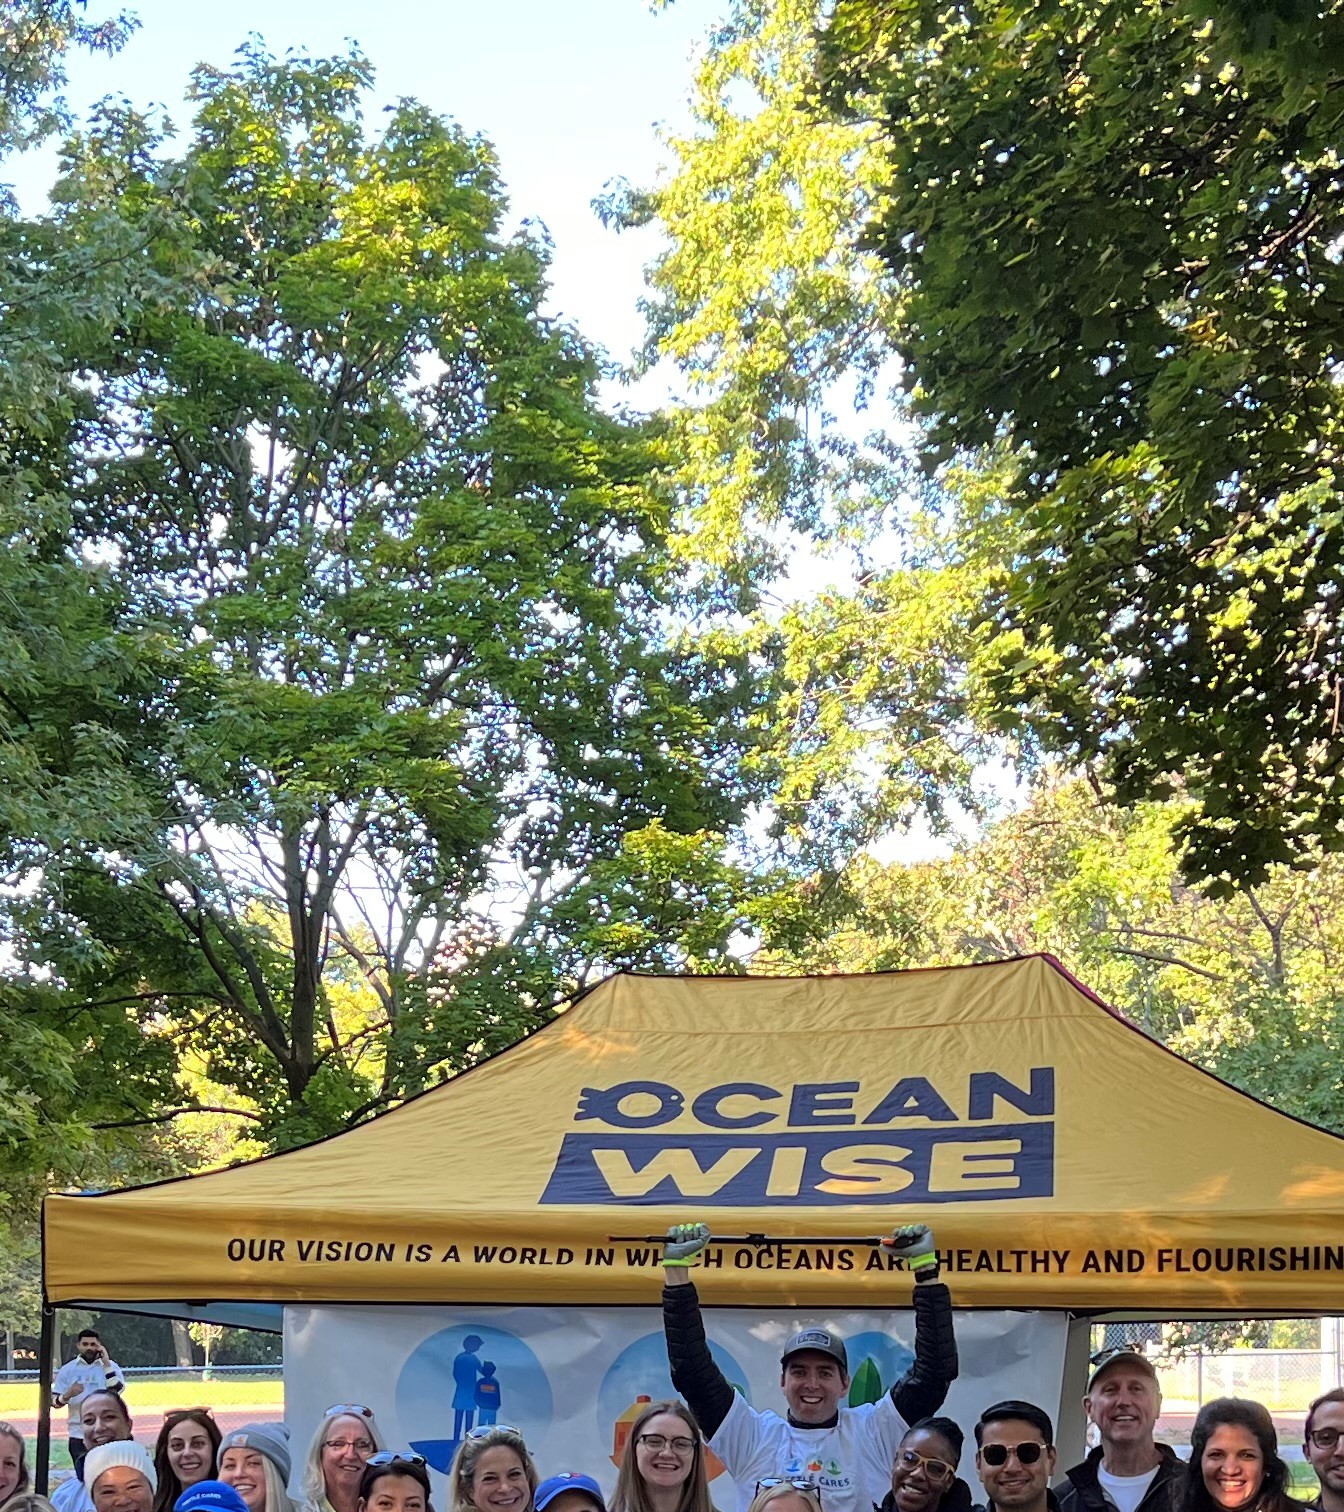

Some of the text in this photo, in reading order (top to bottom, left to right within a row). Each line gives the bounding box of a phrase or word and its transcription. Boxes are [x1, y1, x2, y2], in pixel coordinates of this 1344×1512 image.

[574, 1067, 1055, 1128] OCEAN
[592, 1138, 1023, 1197] WISE
[227, 1238, 286, 1262] OUR
[297, 1239, 396, 1262] VISION
[405, 1243, 432, 1262] IS
[441, 1244, 461, 1263] A
[473, 1245, 575, 1265] WORLD
[584, 1247, 615, 1267] IN
[626, 1248, 723, 1269] WHH
[734, 1247, 855, 1271] OCEANS
[864, 1249, 912, 1271] AR
[935, 1248, 1071, 1274] HEALTHY
[1081, 1249, 1146, 1273] AND
[818, 1475, 850, 1488] CARES
